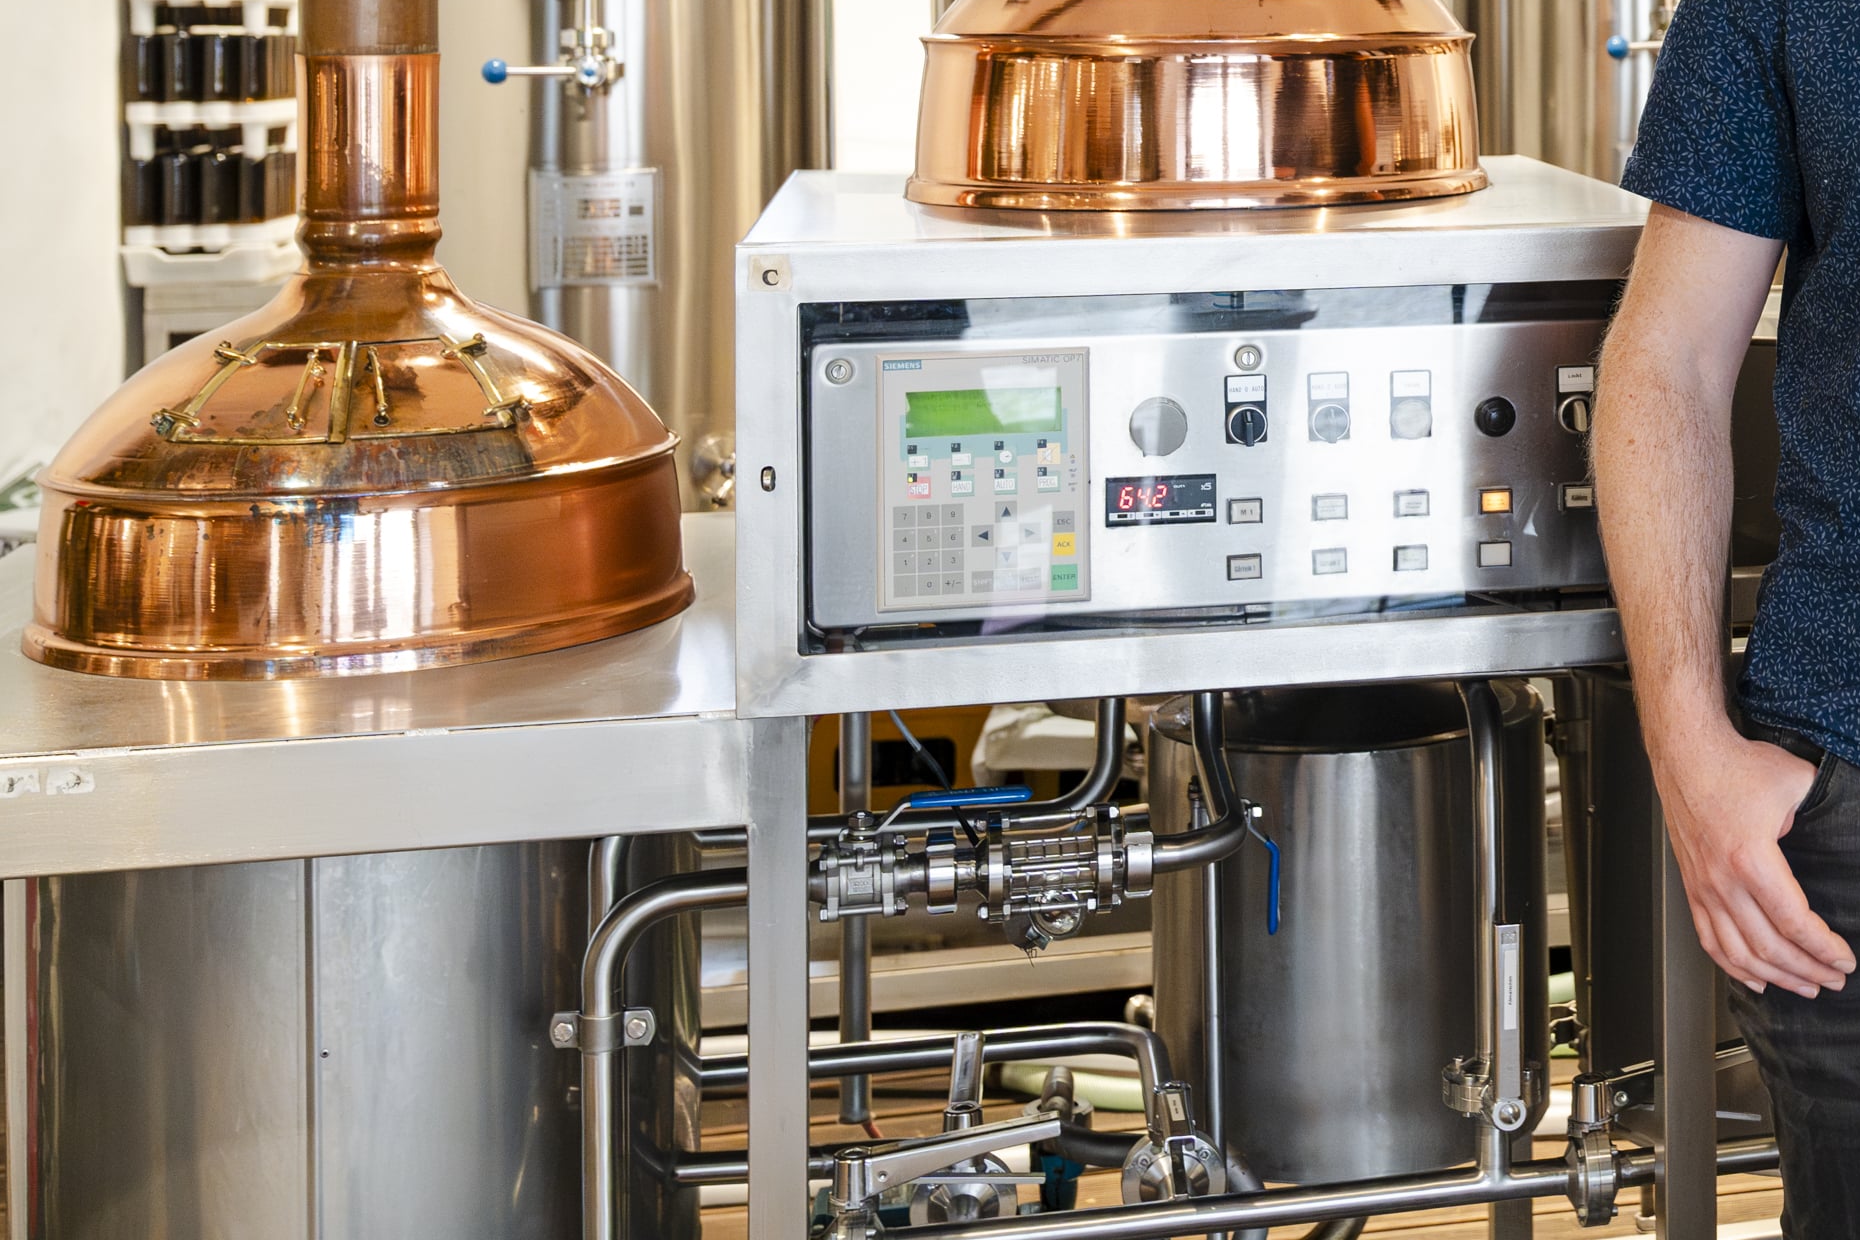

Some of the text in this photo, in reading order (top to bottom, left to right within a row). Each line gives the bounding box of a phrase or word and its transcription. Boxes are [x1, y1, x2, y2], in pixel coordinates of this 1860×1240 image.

[762, 269, 780, 286] C
[1022, 354, 1060, 365] SIMATIC
[883, 361, 921, 371] SIEMENS
[909, 483, 928, 496] STOP
[952, 481, 972, 493] HAND
[995, 479, 1015, 490] AUTO
[1119, 485, 1168, 509] 64.2
[1056, 518, 1071, 526] ESC
[1052, 573, 1077, 582] ENTER
